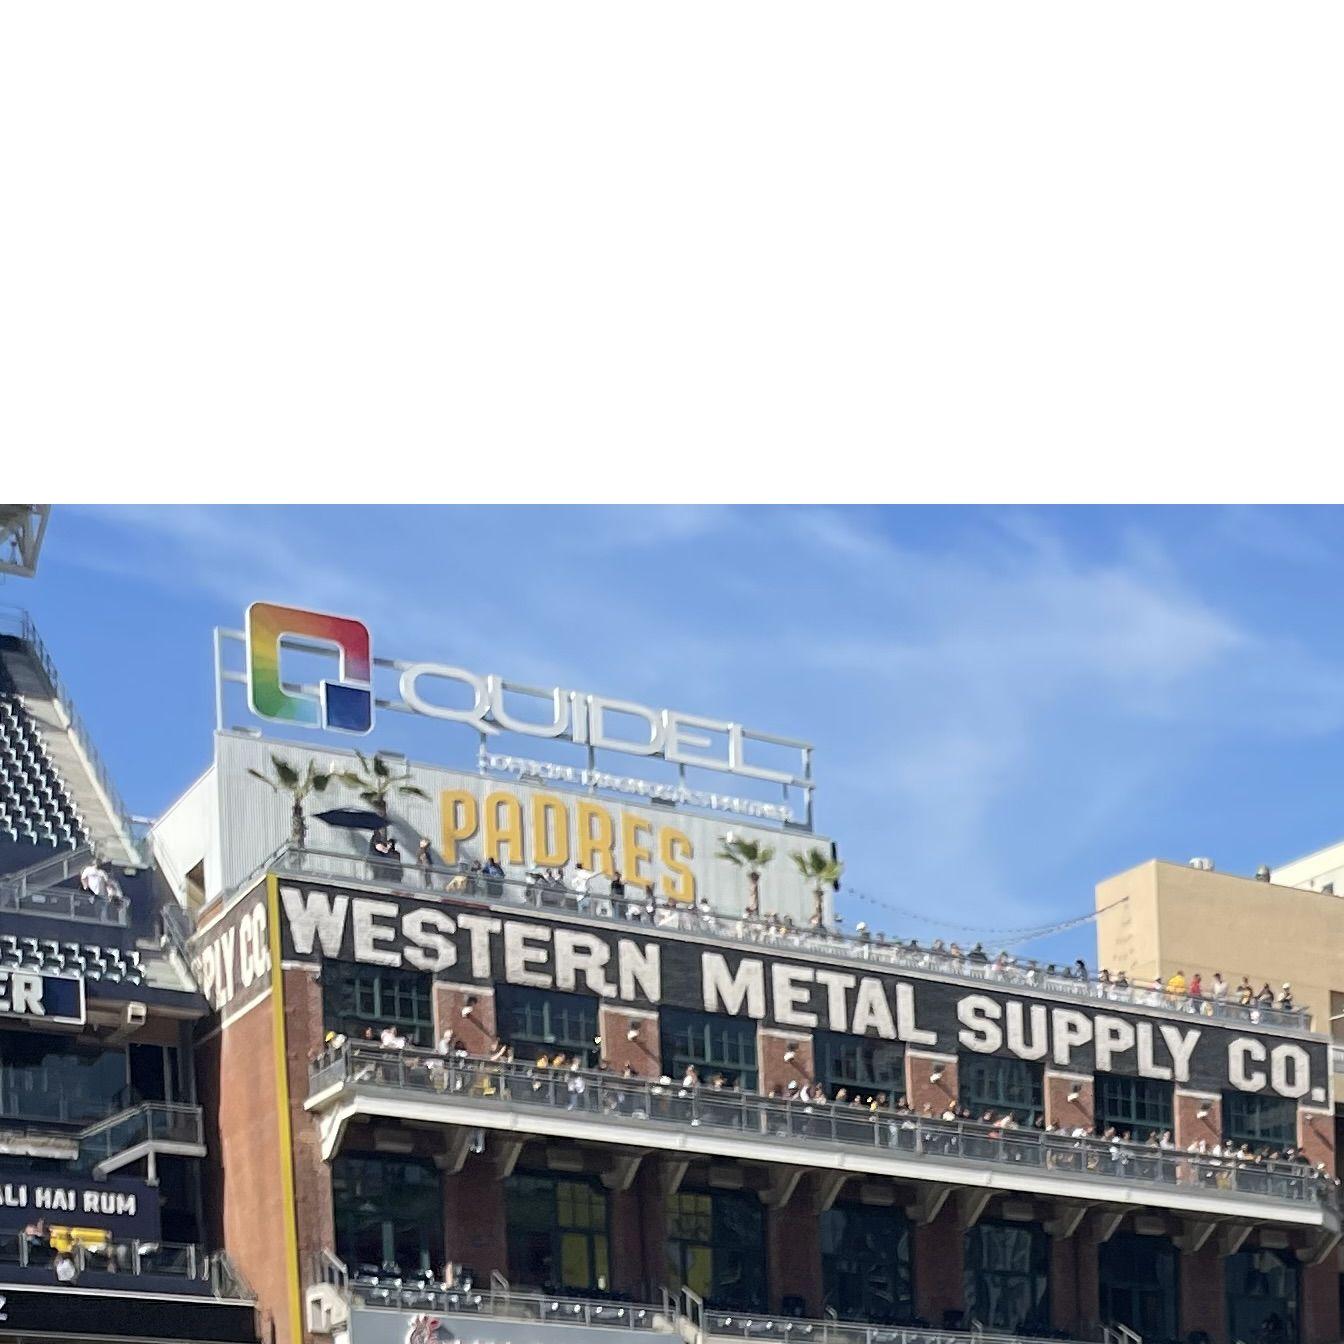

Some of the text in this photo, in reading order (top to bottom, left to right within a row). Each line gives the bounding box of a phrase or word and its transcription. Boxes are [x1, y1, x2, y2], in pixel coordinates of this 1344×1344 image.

[399, 663, 797, 784] QUIDEL
[440, 789, 697, 903] PADRES
[281, 886, 1325, 1103] WESTERN METAL SUPPLY CO.
[35, 1186, 76, 1211] HAI
[83, 1190, 137, 1216] RUM
